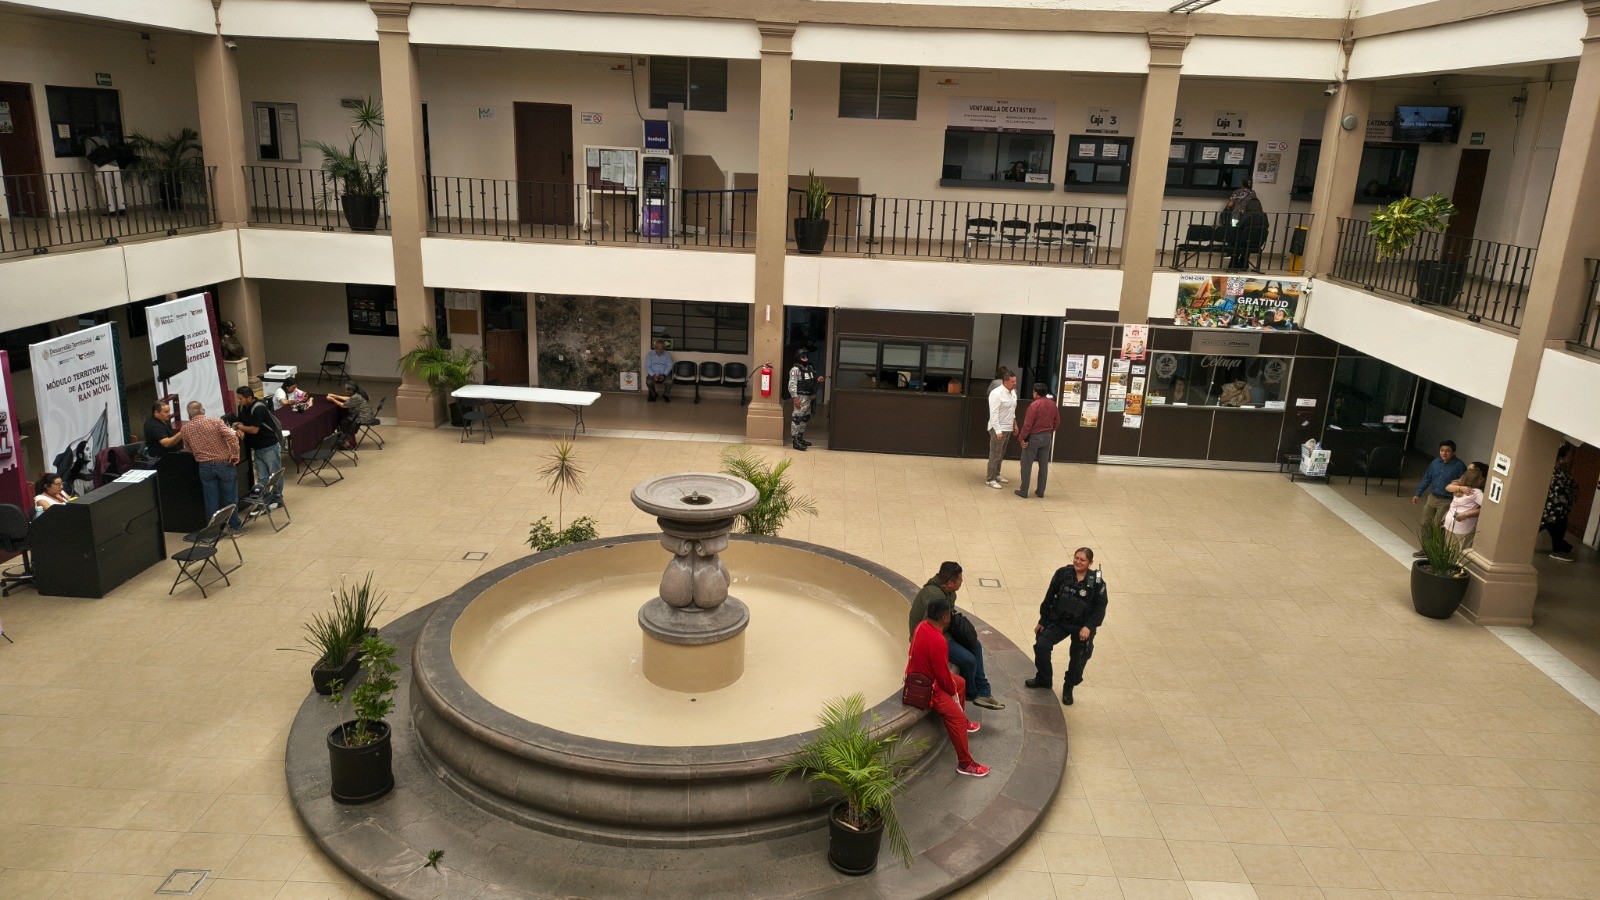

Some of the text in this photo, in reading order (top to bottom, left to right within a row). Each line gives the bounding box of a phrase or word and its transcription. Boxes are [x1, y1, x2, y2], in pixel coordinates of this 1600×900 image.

[969, 104, 1000, 112] VENTANILLA
[1009, 106, 1037, 114] CATASTRO
[1090, 114, 1117, 126] Caja 3
[1174, 118, 1182, 128] 2
[1217, 117, 1243, 129] Caja 1
[1371, 119, 1394, 127] ATENCIÓ
[1237, 296, 1289, 308] GRATITUD
[49, 337, 92, 355] Desarrollo Territorial
[186, 337, 209, 351] cretaría
[187, 350, 211, 364] ienestar
[1200, 355, 1242, 370] Celaya
[46, 363, 109, 391] MÓDULO TERRITORIAL
[68, 372, 110, 393] DE ATENCIÓN
[78, 383, 112, 402] RAN MÓVIL
